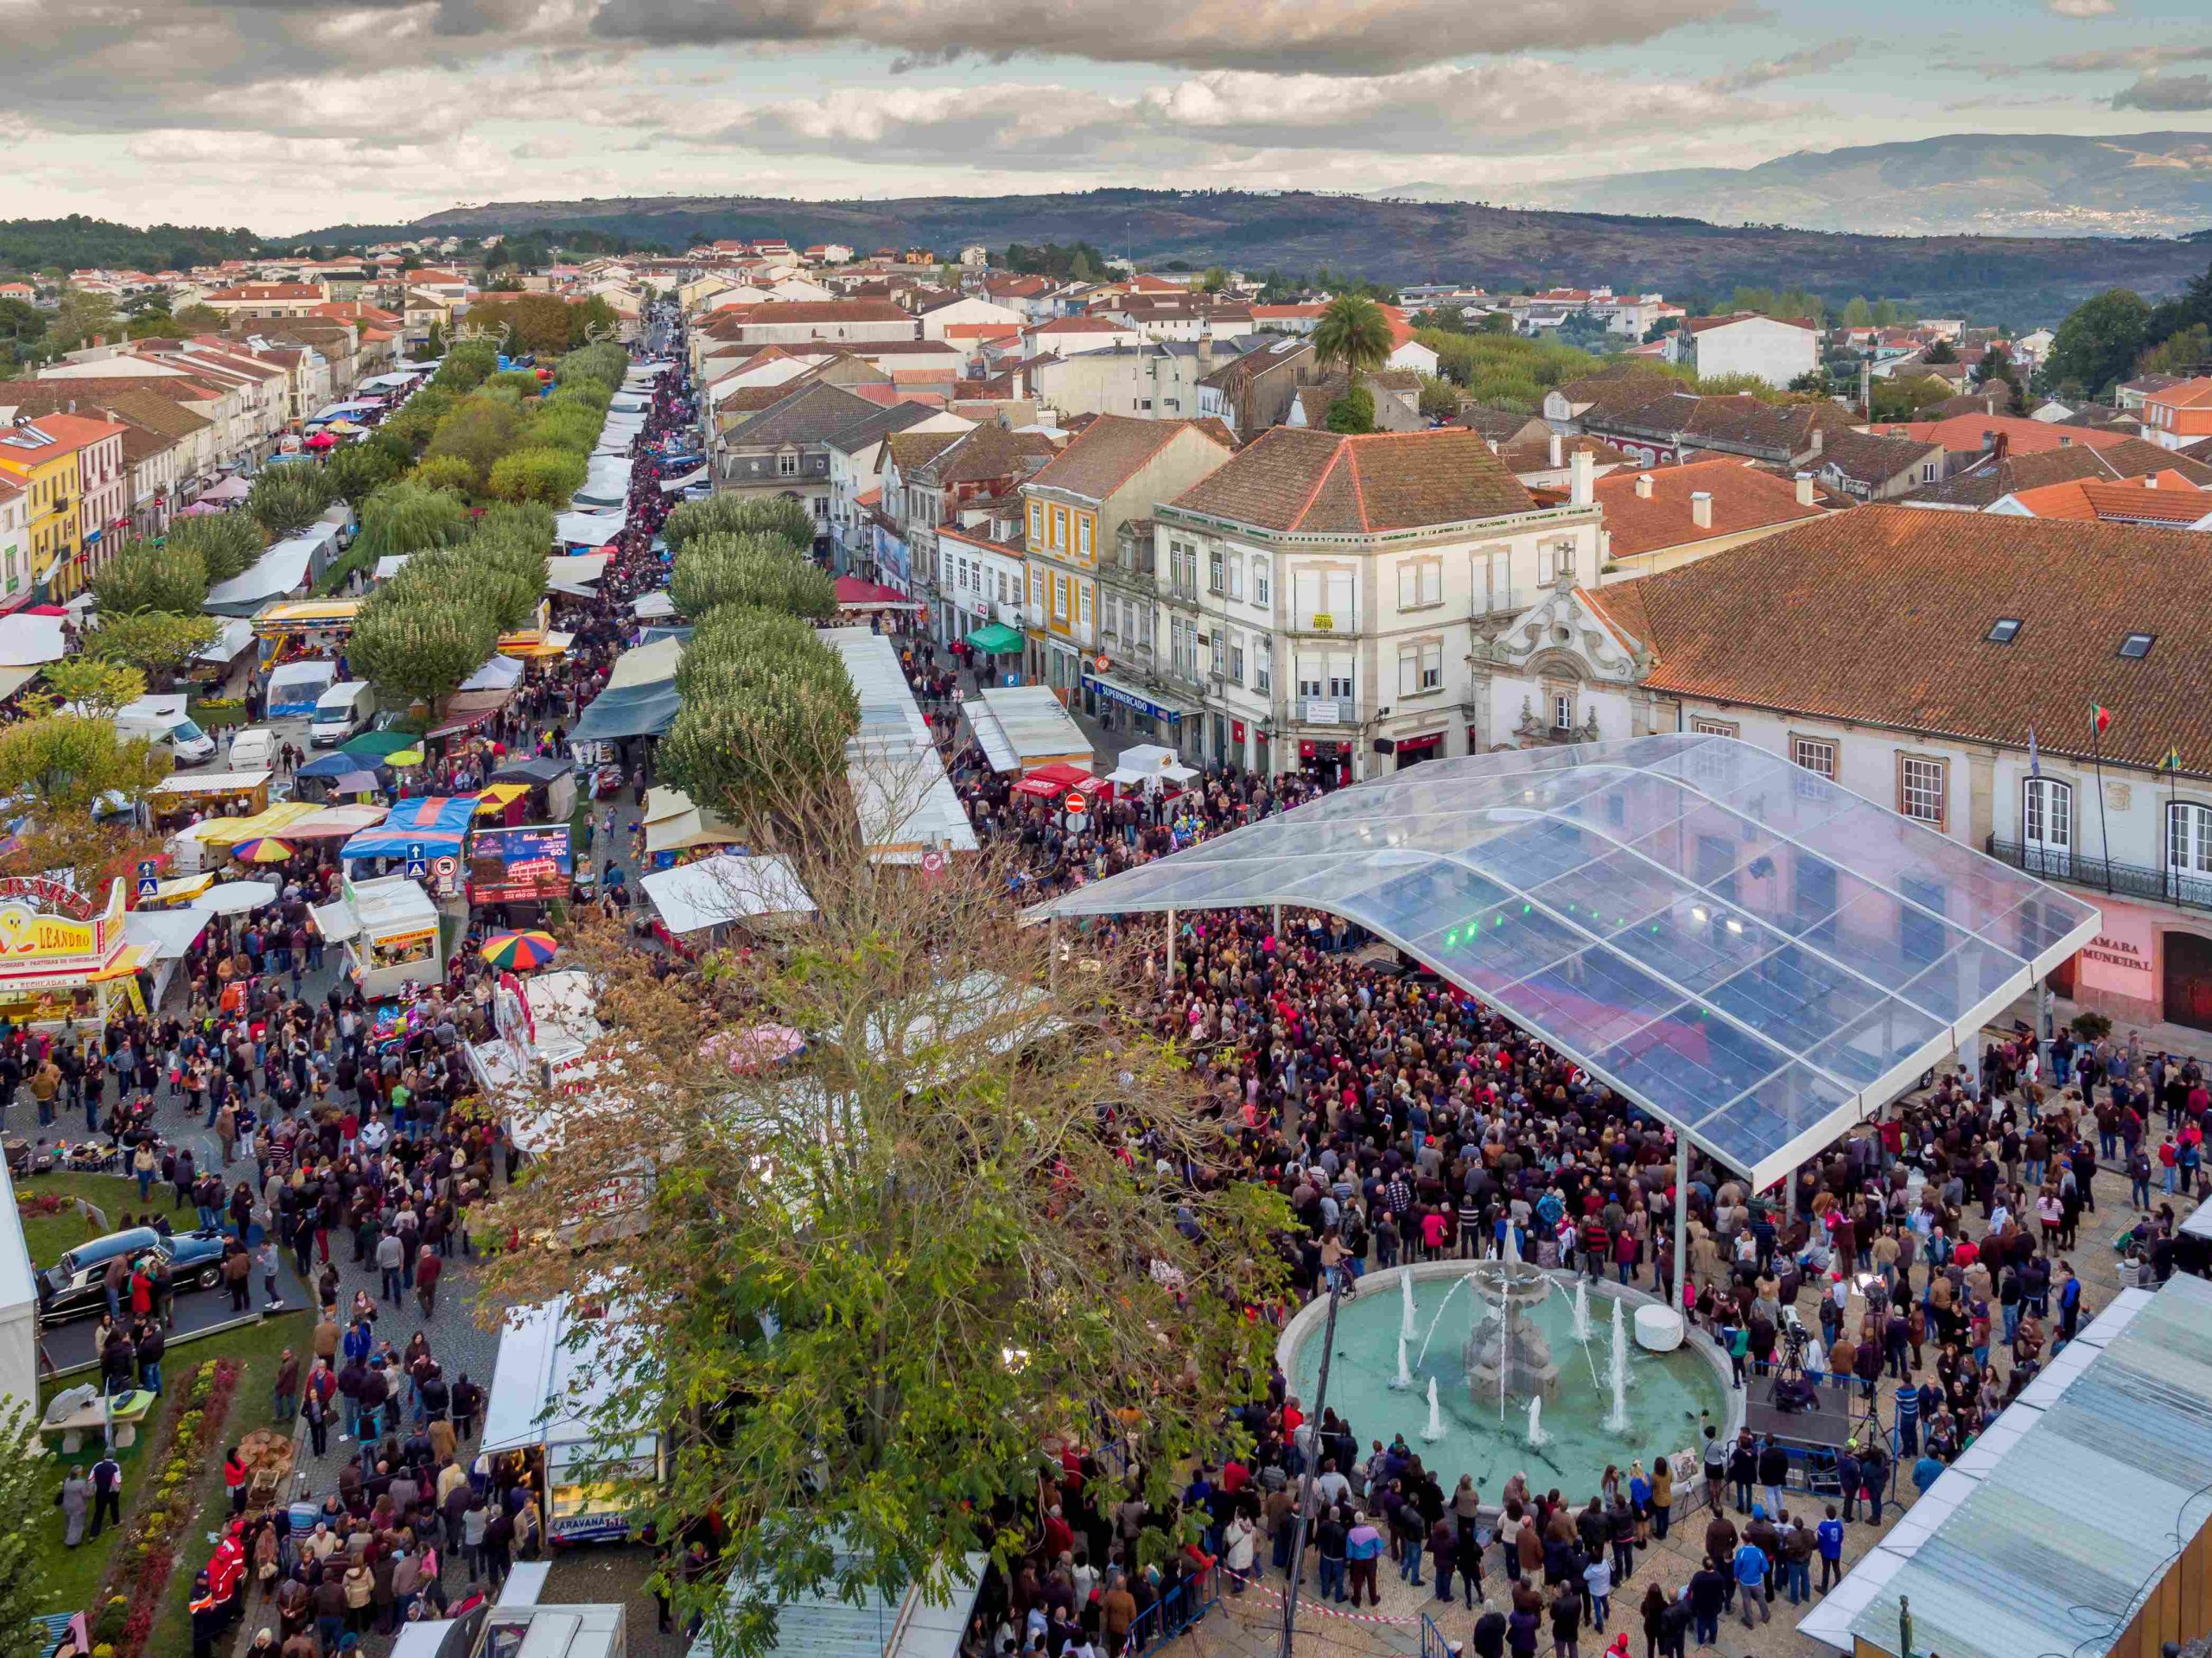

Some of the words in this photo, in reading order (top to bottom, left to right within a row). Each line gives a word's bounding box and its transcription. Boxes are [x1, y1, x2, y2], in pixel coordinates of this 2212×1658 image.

[1007, 675, 1014, 685] P
[1102, 685, 1147, 712] SUPERMERCADO
[40, 927, 90, 950] LEANDRO
[2082, 949, 2152, 972] MUNICIPAL
[1830, 1528, 1839, 1542] 9
